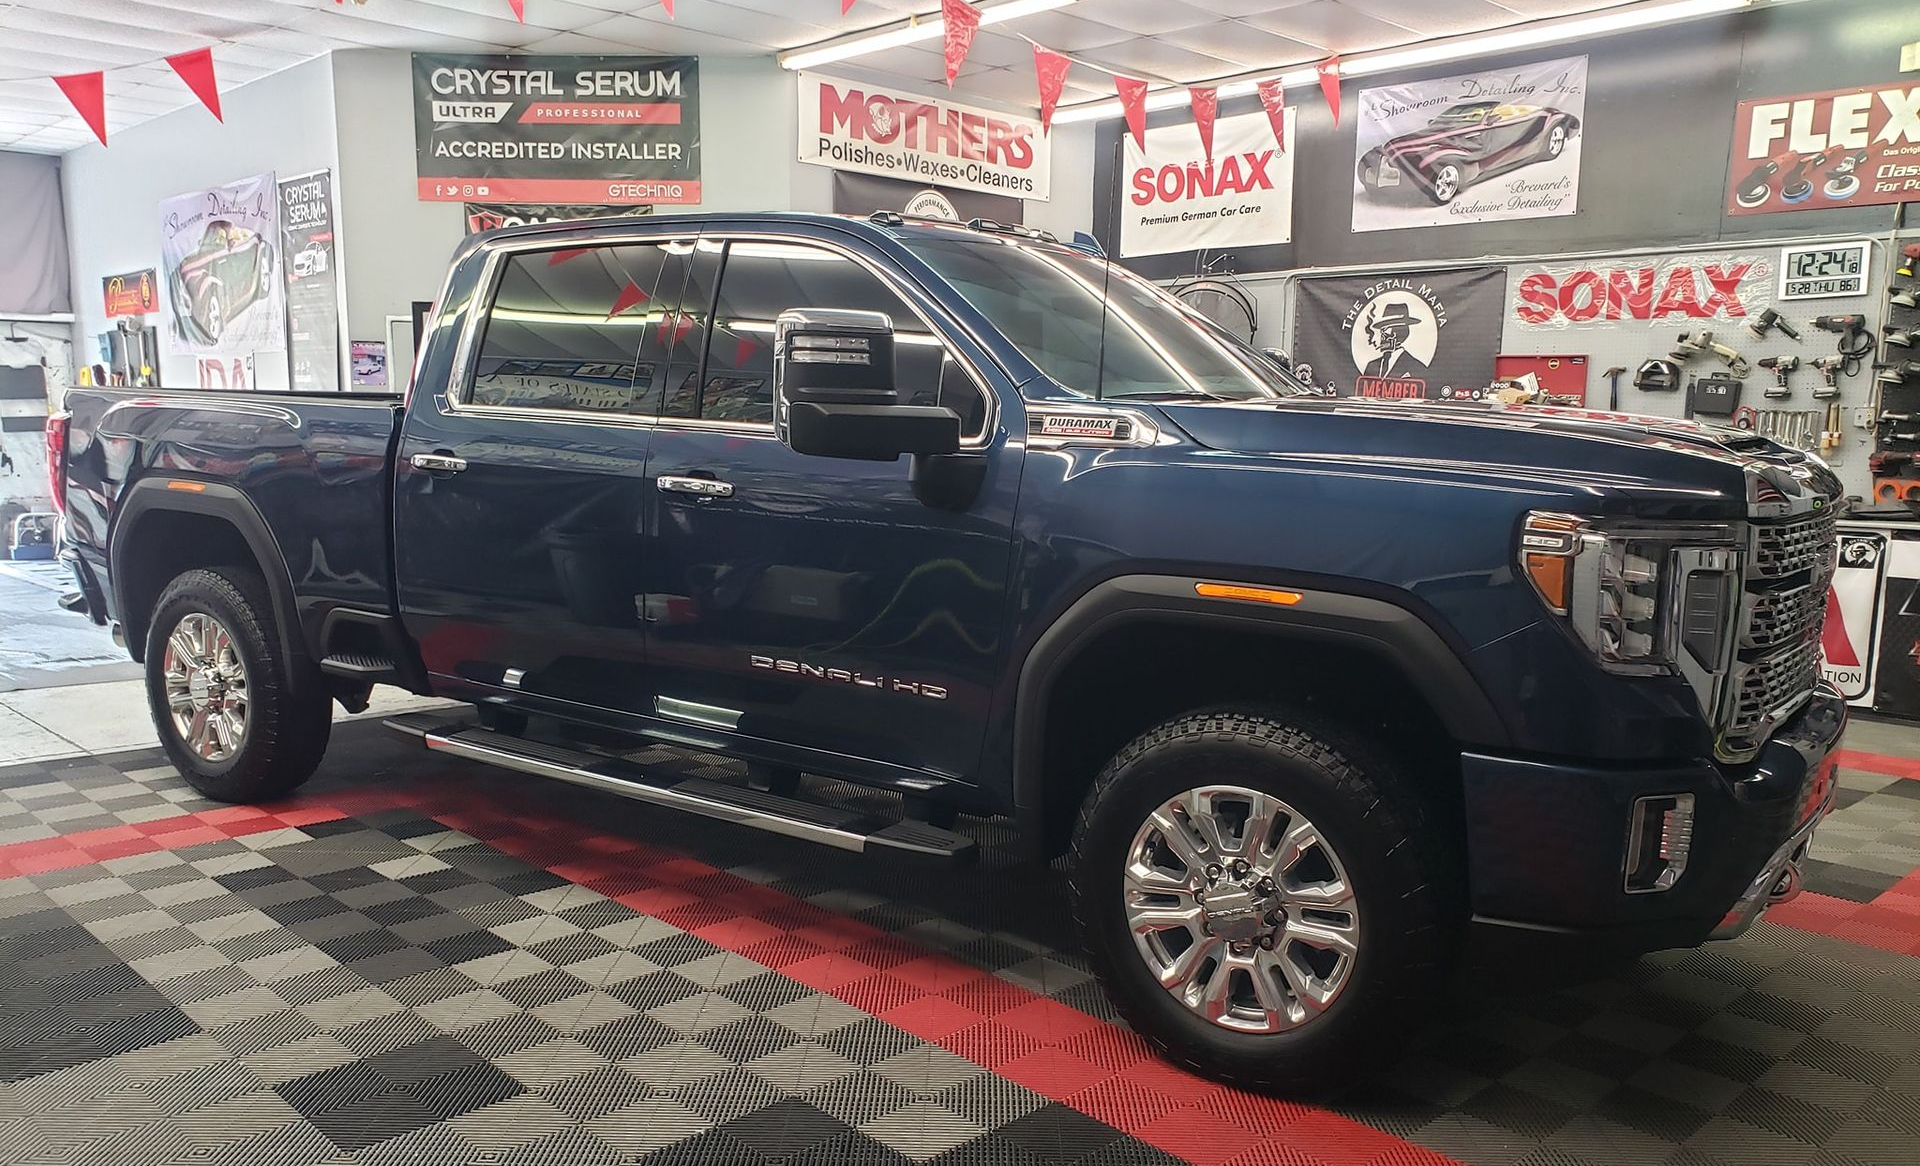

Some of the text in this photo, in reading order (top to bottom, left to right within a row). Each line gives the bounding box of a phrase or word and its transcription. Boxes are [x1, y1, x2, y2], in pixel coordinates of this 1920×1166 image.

[431, 67, 681, 97] CRYSTAL SERUM
[1458, 74, 1536, 100] Detailing
[1543, 72, 1582, 95] Inc.
[439, 105, 496, 119] ULTRA
[536, 108, 643, 119] PROFESSIONAL
[1747, 86, 1920, 160] FLEX
[819, 82, 1034, 170] MOTHERS
[435, 140, 683, 160] ACCREDITED INSTALLER
[819, 137, 1034, 192] Polishes Waxes Cleaners
[1876, 163, 1920, 178] Clas
[1131, 149, 1276, 206] SONAX
[1874, 181, 1901, 193] For
[285, 181, 325, 206] CRYSTAL
[608, 183, 683, 199] GTECHNIQ
[289, 203, 322, 224] SERUM
[914, 198, 950, 218] PERFORMANCE
[1140, 204, 1262, 227] Premium German Car Care
[1449, 201, 1503, 216] Exclusive
[1797, 250, 1847, 277] 12:24
[1341, 278, 1448, 331] THE DETAIL MAFIA
[1516, 263, 1752, 325] SONAX
[1049, 417, 1112, 429] DURAMAX
[751, 655, 948, 700] DENALI HD
